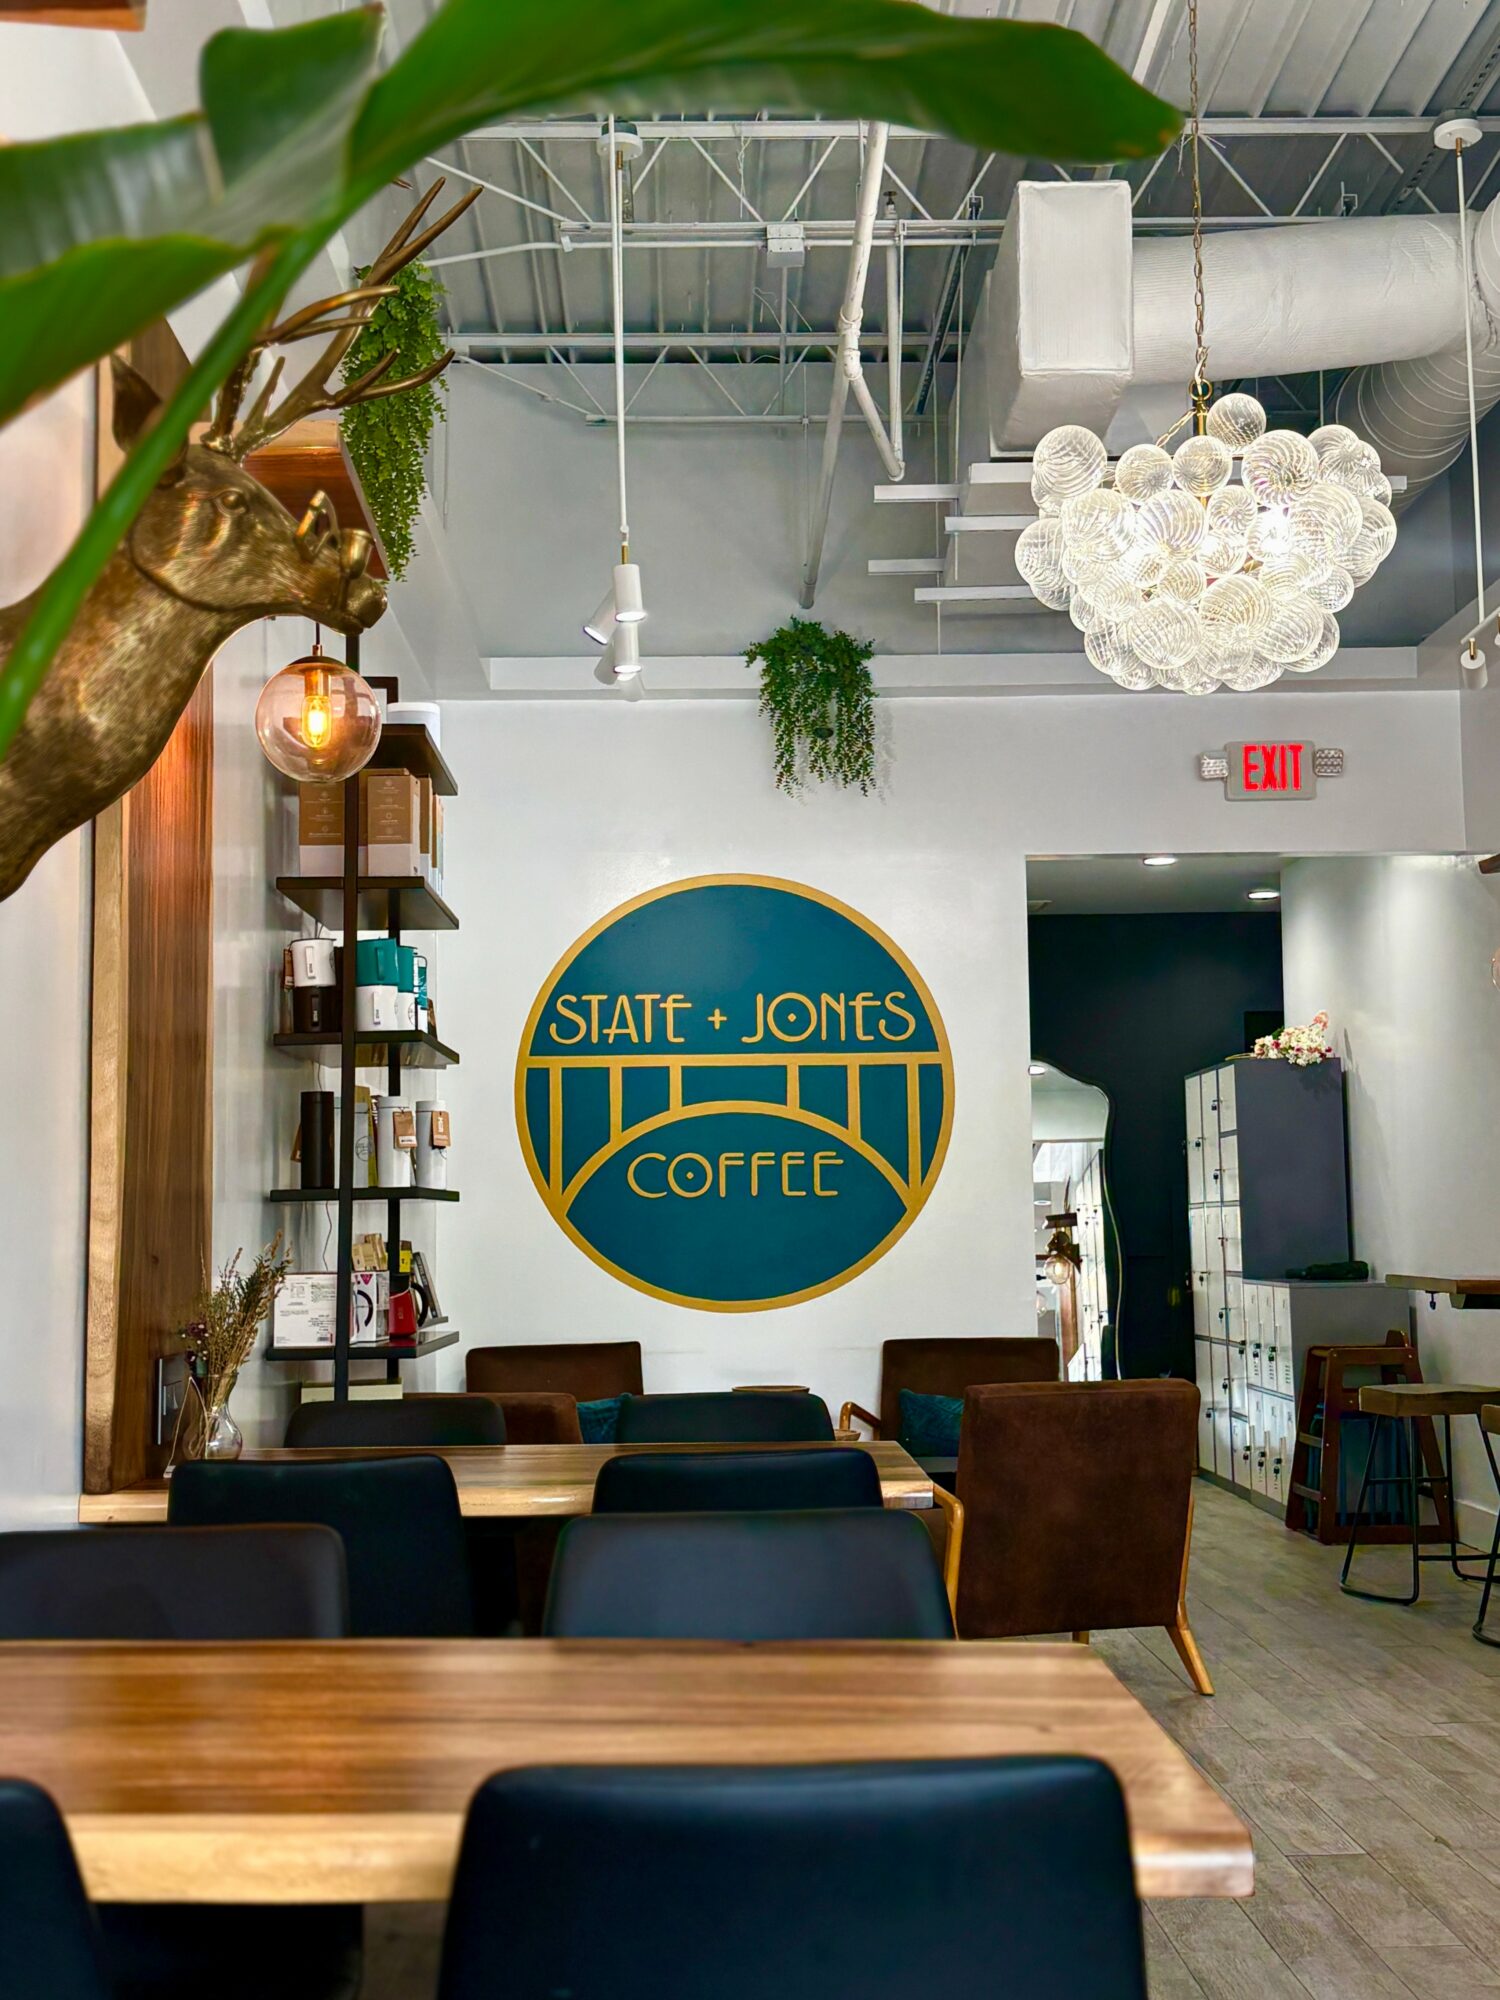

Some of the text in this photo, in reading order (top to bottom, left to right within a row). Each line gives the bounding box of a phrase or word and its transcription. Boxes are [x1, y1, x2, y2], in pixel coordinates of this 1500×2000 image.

[1243, 744, 1304, 792] EXIT
[549, 992, 916, 1044] STATE + JONES
[627, 1151, 844, 1198] COFFEE
